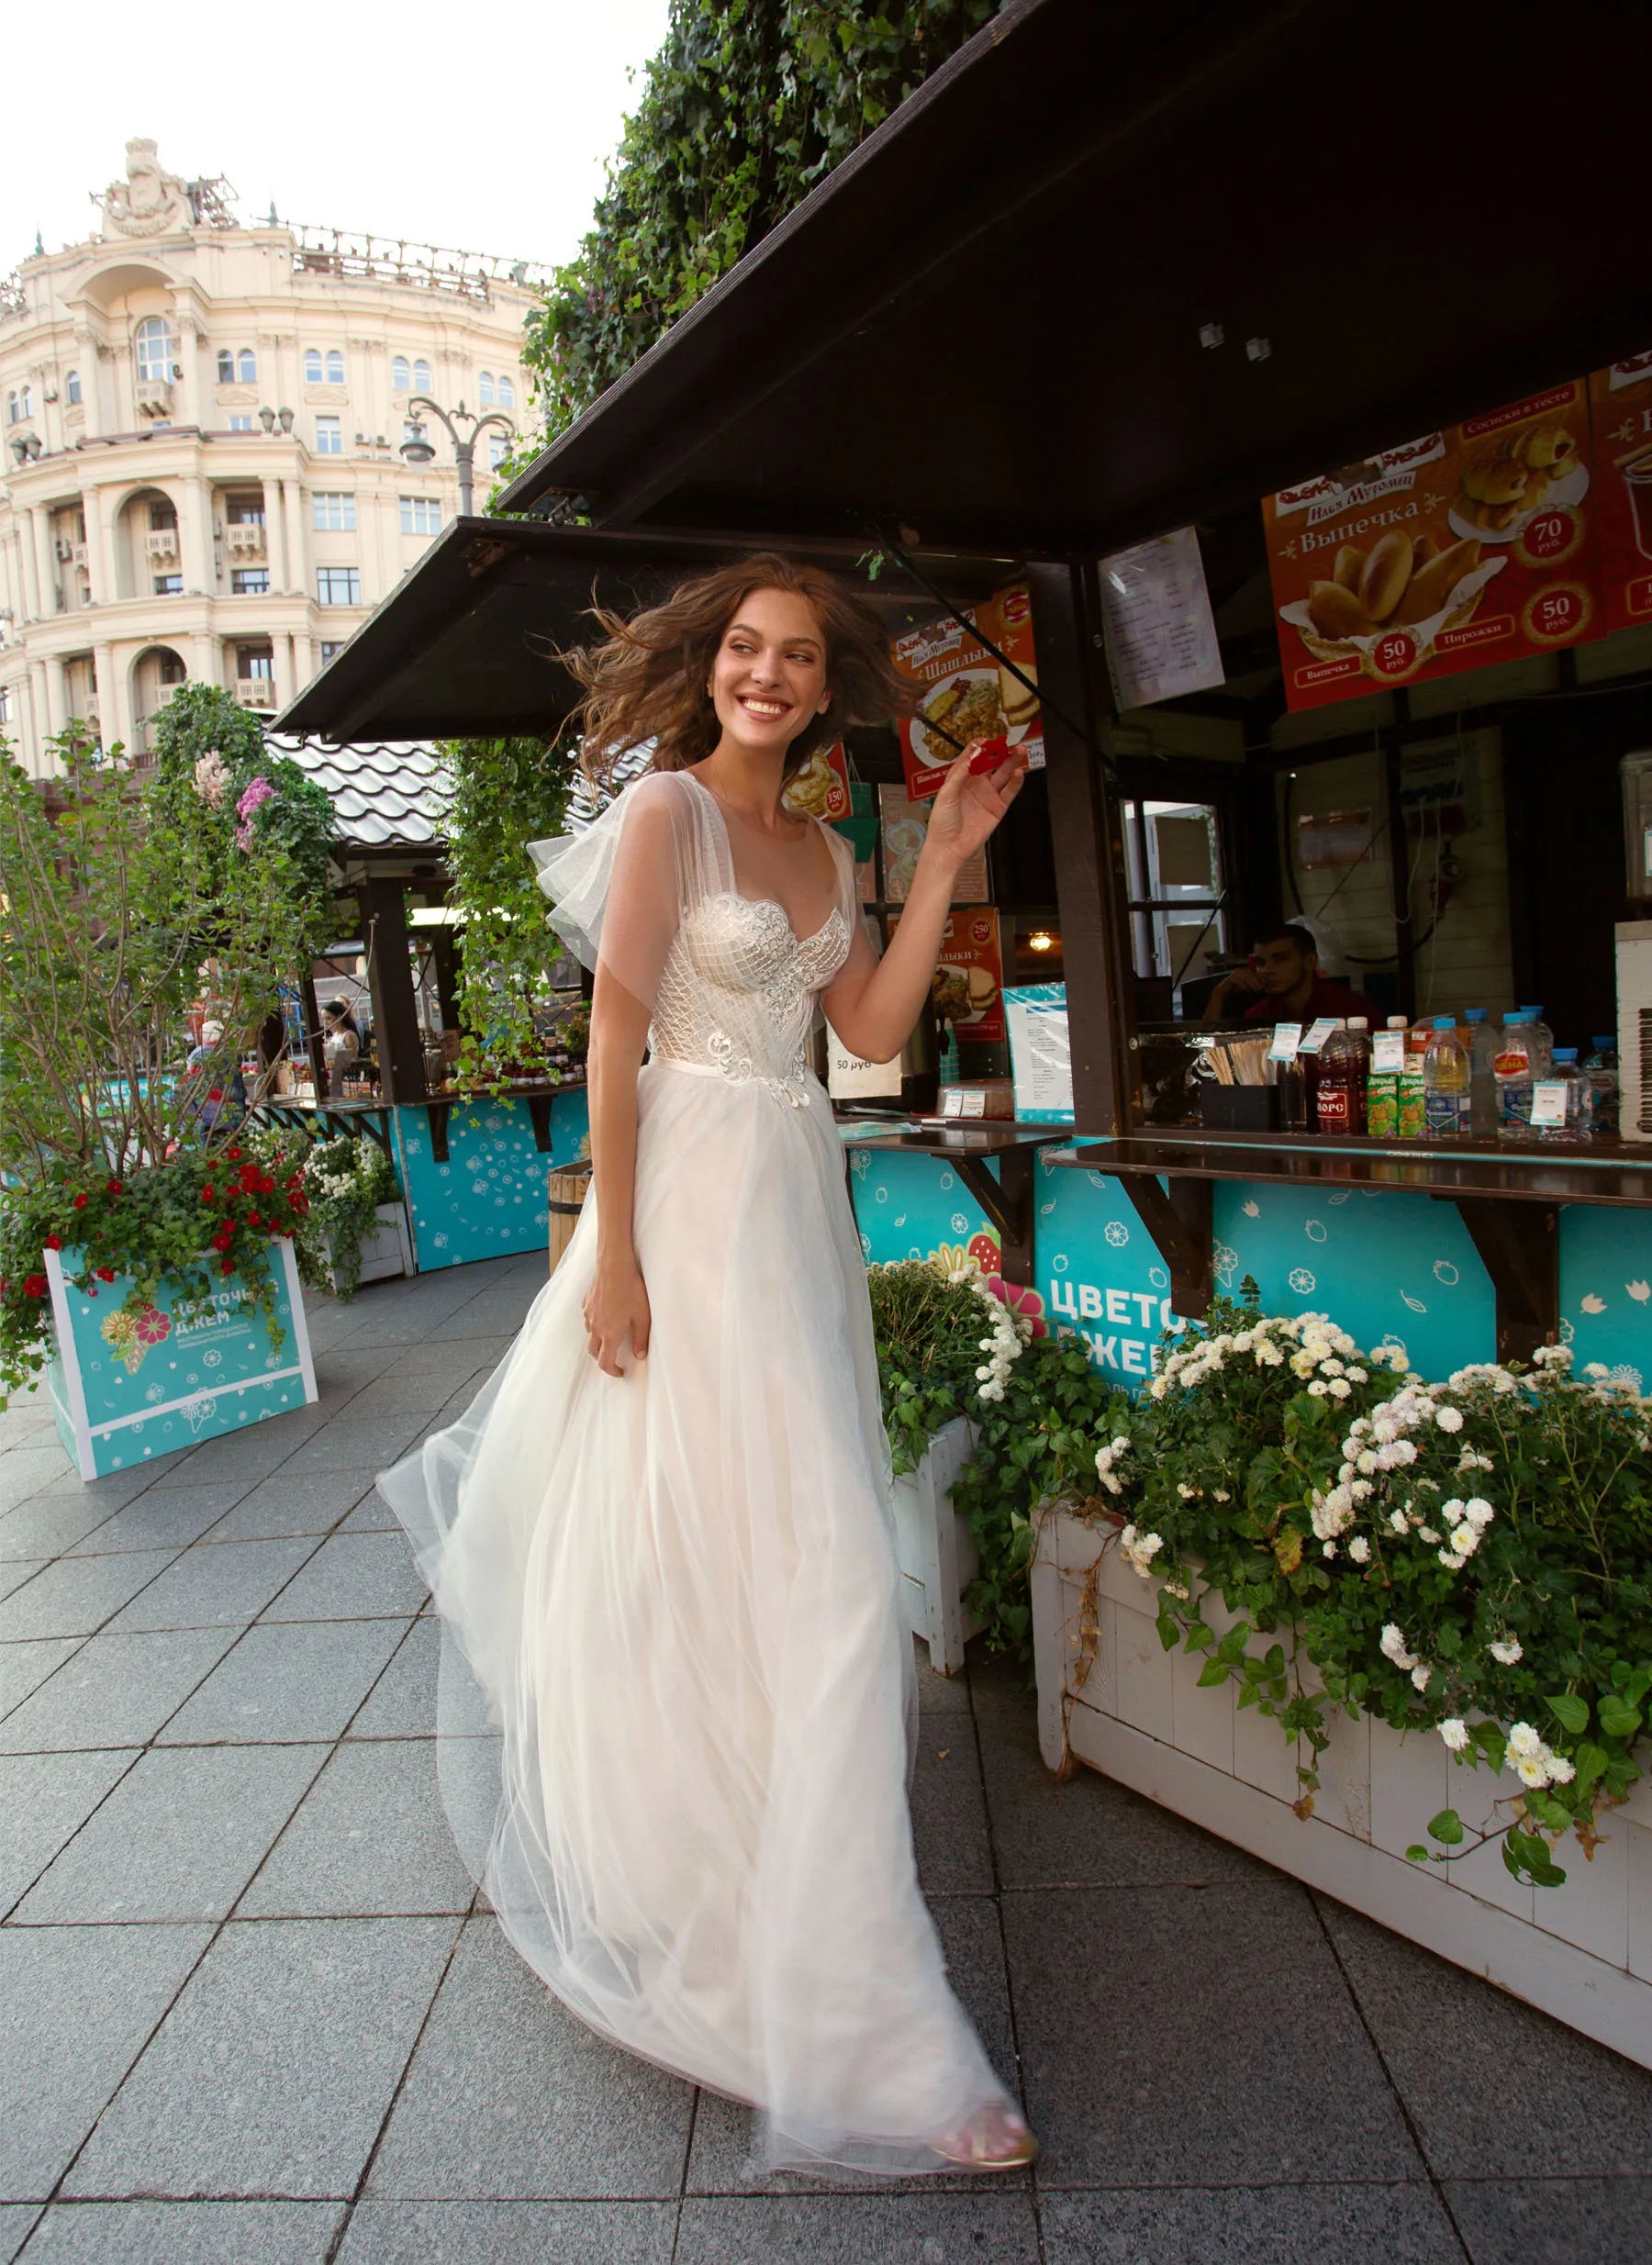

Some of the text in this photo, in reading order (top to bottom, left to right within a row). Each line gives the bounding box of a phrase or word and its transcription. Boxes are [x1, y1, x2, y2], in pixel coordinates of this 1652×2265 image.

[1468, 409, 1521, 433] Сосиски
[1532, 390, 1570, 410] тесте
[1347, 475, 1413, 505] Муромец
[1300, 501, 1419, 553] Выпечка
[1535, 519, 1562, 541] 70
[1542, 597, 1570, 619] 50
[1444, 624, 1501, 645] Пирожки
[1383, 639, 1406, 660] 50
[1306, 662, 1350, 681] Выпечка
[828, 789, 843, 804] 150
[975, 924, 988, 934] 250
[837, 1059, 872, 1071] 50 руб
